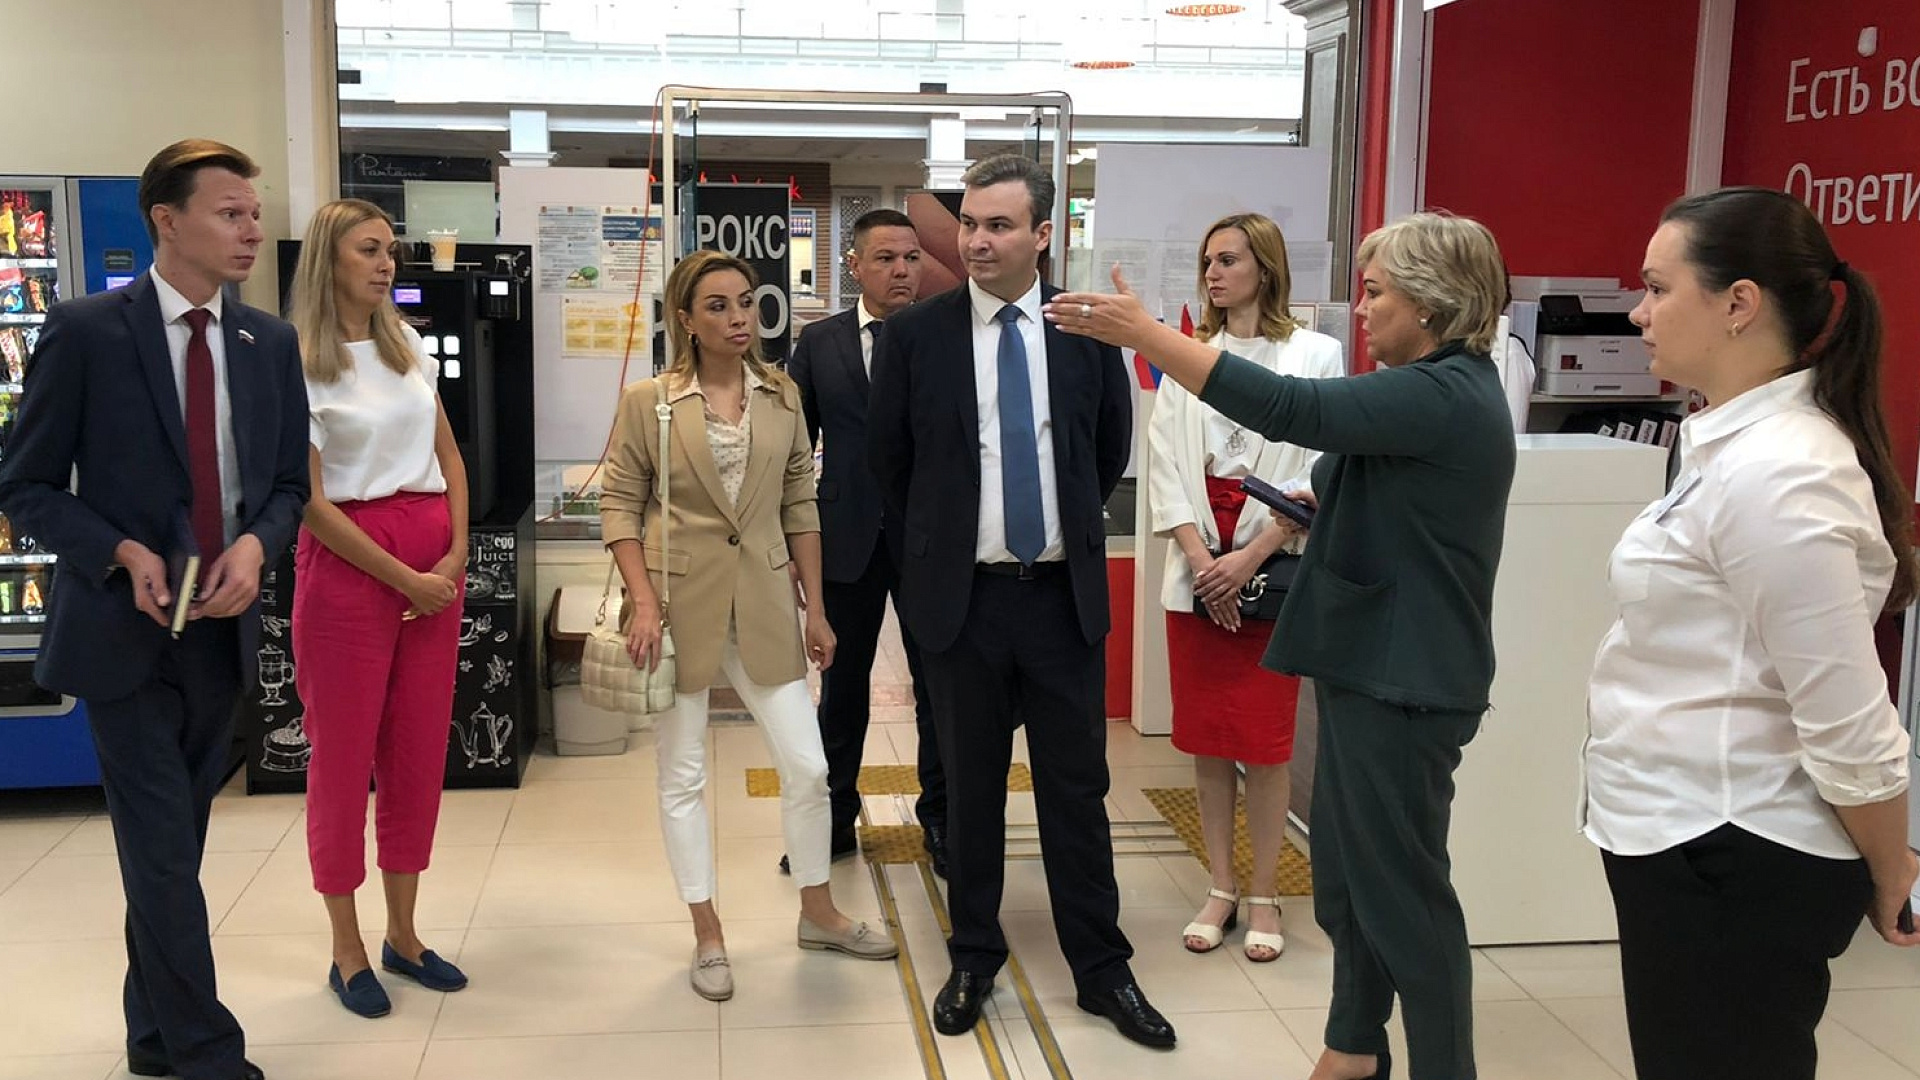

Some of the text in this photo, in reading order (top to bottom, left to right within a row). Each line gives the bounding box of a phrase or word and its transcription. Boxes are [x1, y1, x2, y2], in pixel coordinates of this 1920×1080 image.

[1786, 57, 1871, 123] Есть
[1784, 162, 1920, 225] Ответи
[674, 214, 787, 260] РОКС
